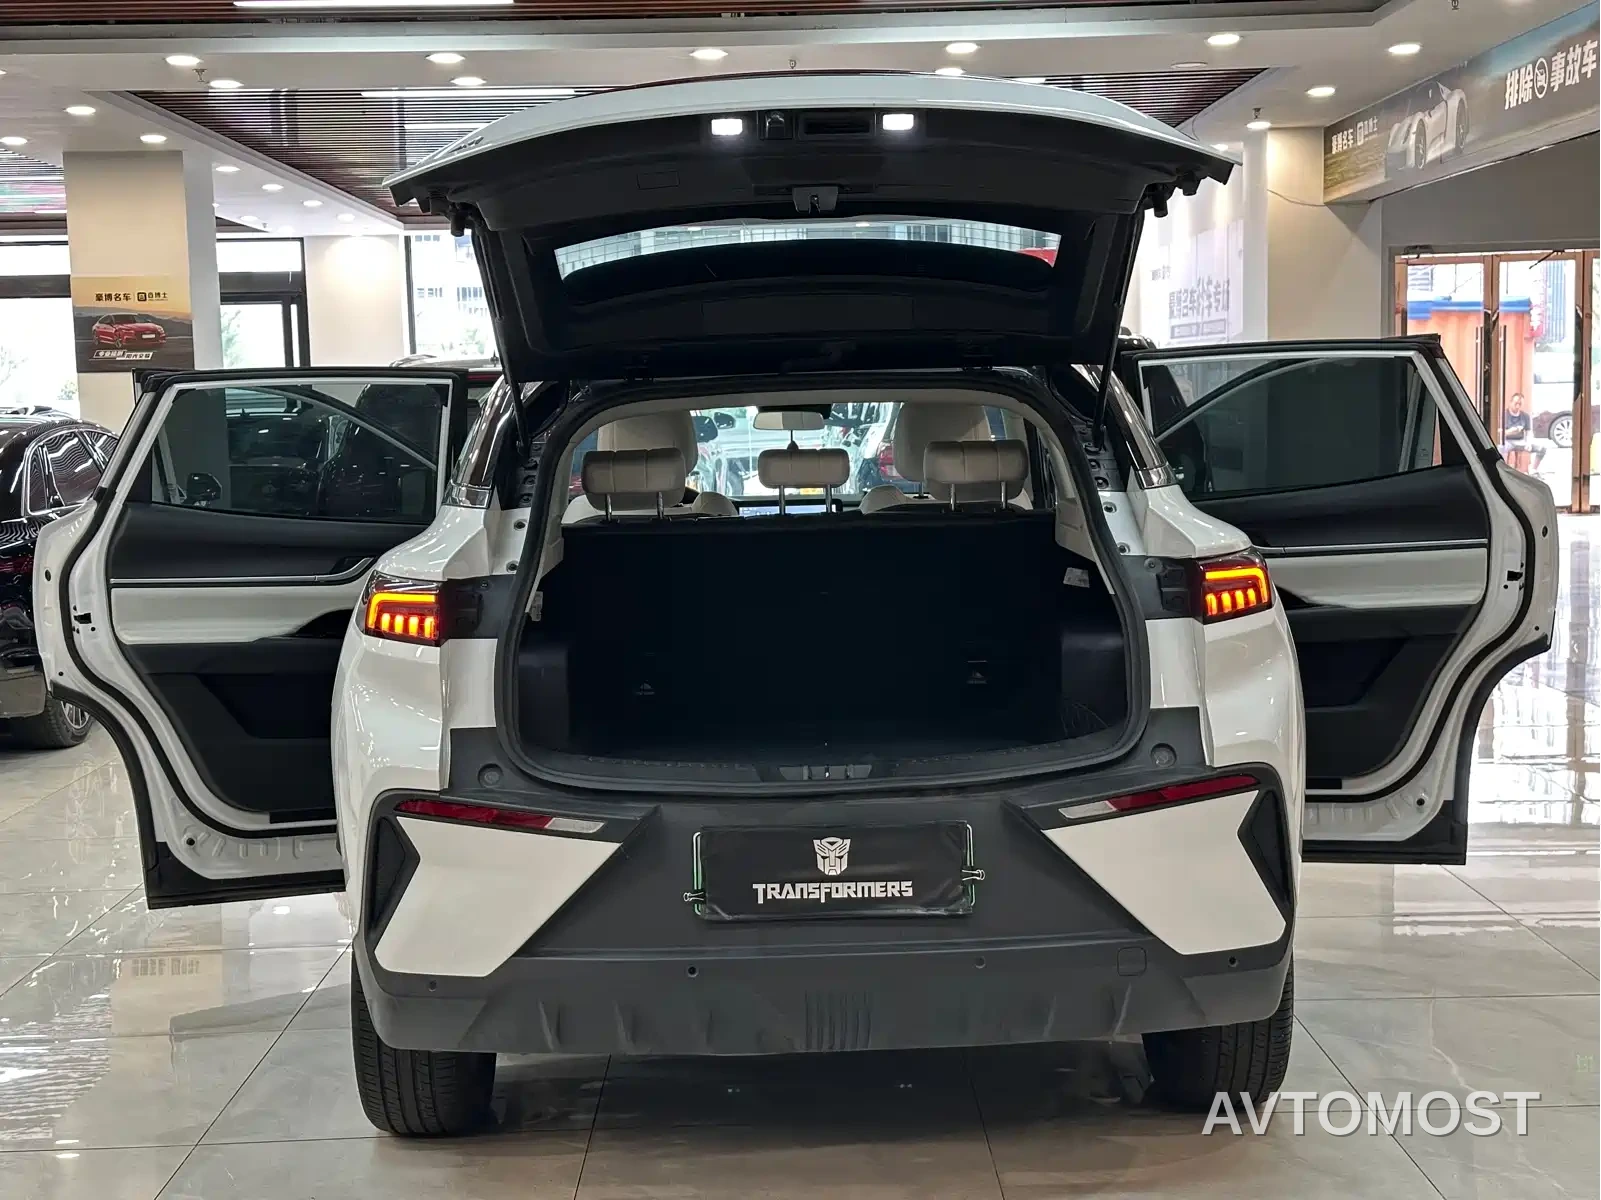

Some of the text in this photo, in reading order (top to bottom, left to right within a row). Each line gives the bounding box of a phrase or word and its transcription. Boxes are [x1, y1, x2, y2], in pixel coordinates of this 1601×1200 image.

[1504, 39, 1598, 110] 排除 事故车
[95, 293, 132, 302] 豪博名车
[752, 880, 913, 904] TRANSFORMERS
